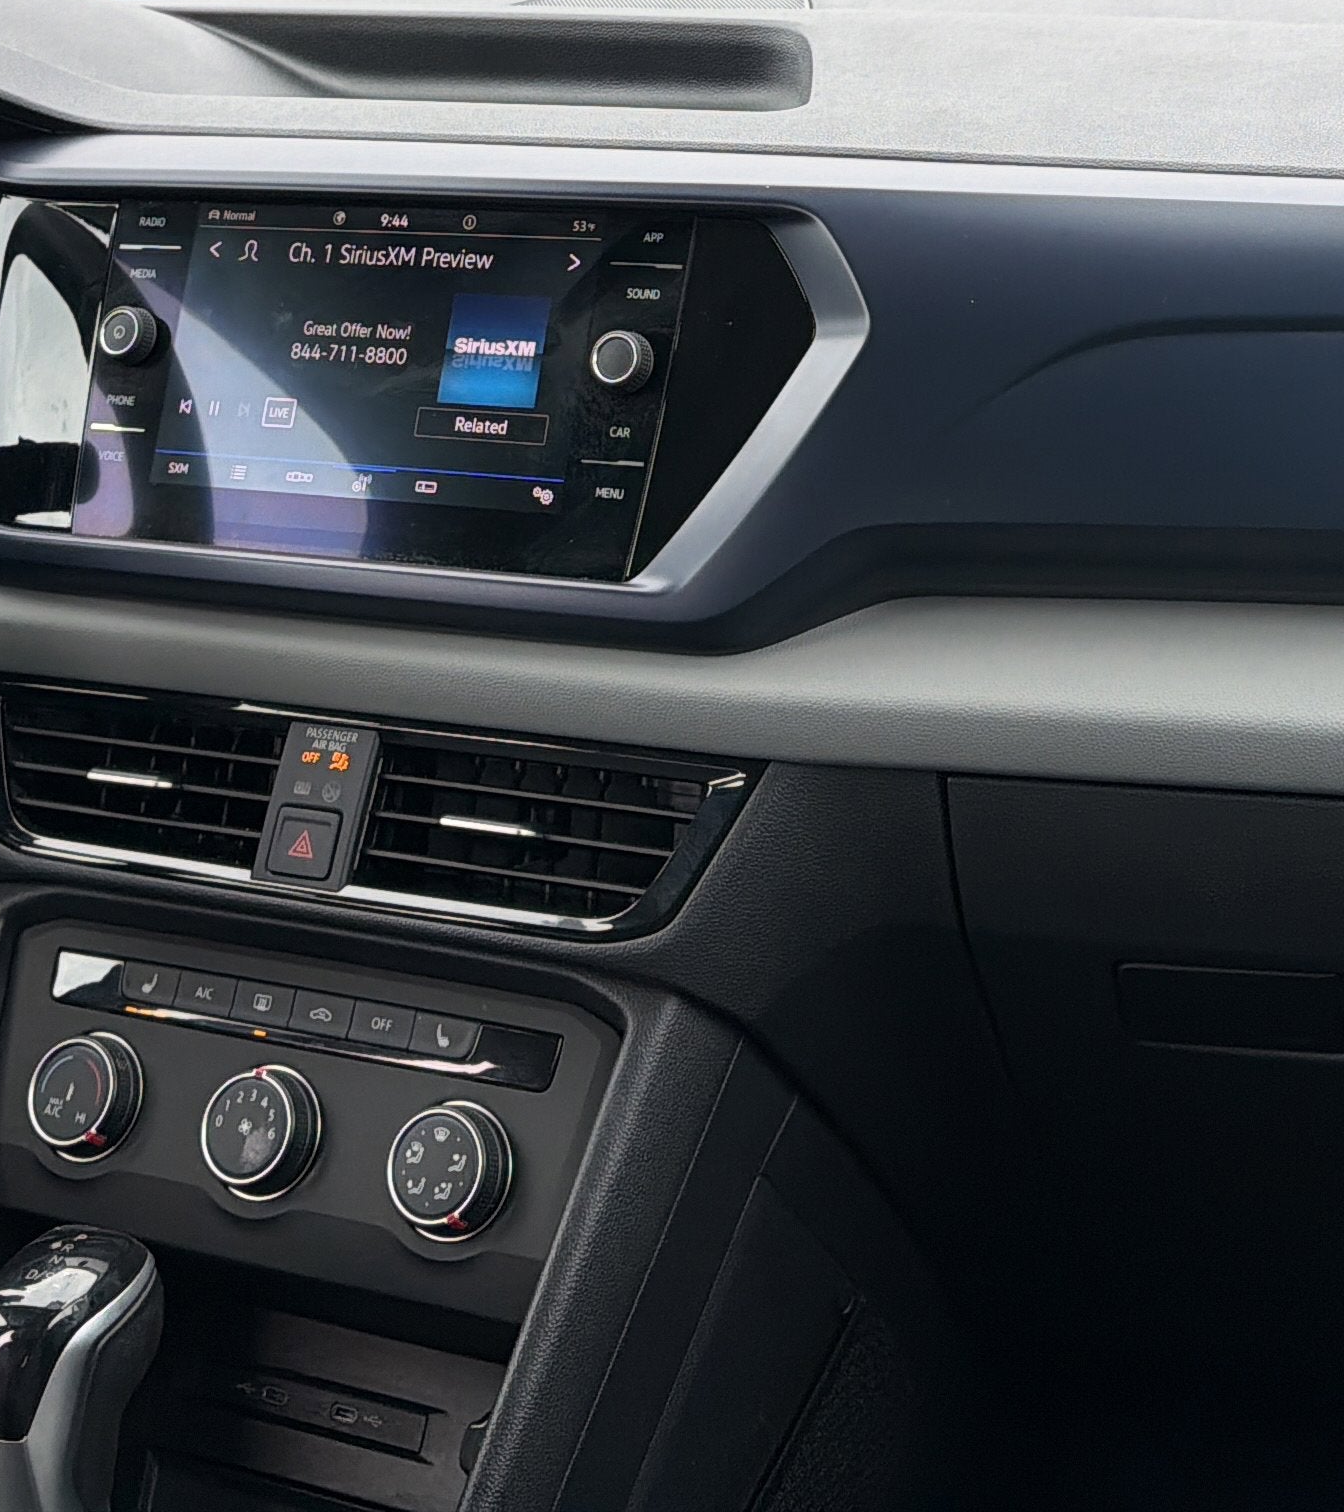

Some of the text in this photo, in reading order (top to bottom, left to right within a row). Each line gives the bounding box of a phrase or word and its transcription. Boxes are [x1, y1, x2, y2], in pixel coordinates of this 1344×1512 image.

[139, 216, 166, 227] RADIO
[223, 210, 256, 221] Normal
[380, 214, 409, 228] 9:44
[643, 232, 664, 243] APP
[289, 242, 494, 270] Ch. 1 SiriusXM Preview
[130, 268, 157, 279] MEDIA
[626, 288, 661, 300] SOUND
[303, 321, 412, 340] Great Offer Now!
[290, 342, 407, 365] 844-711-8800
[454, 338, 536, 357] SiriusXM
[106, 394, 136, 406] PHONE
[269, 407, 290, 419] LIVE
[454, 416, 508, 436] Related
[609, 426, 631, 438] CAR
[168, 461, 189, 475] SXM
[595, 487, 625, 500] MENU
[306, 727, 359, 743] PASSENGER
[301, 751, 321, 763] OFF
[194, 986, 213, 1001] A/C
[370, 1015, 393, 1033] OFF
[43, 1103, 63, 1118] A/C
[215, 1089, 276, 1140] 0 1 2 3 4 5 6
[74, 1111, 87, 1125] HI
[60, 1243, 74, 1253] R
[48, 1254, 64, 1265] N
